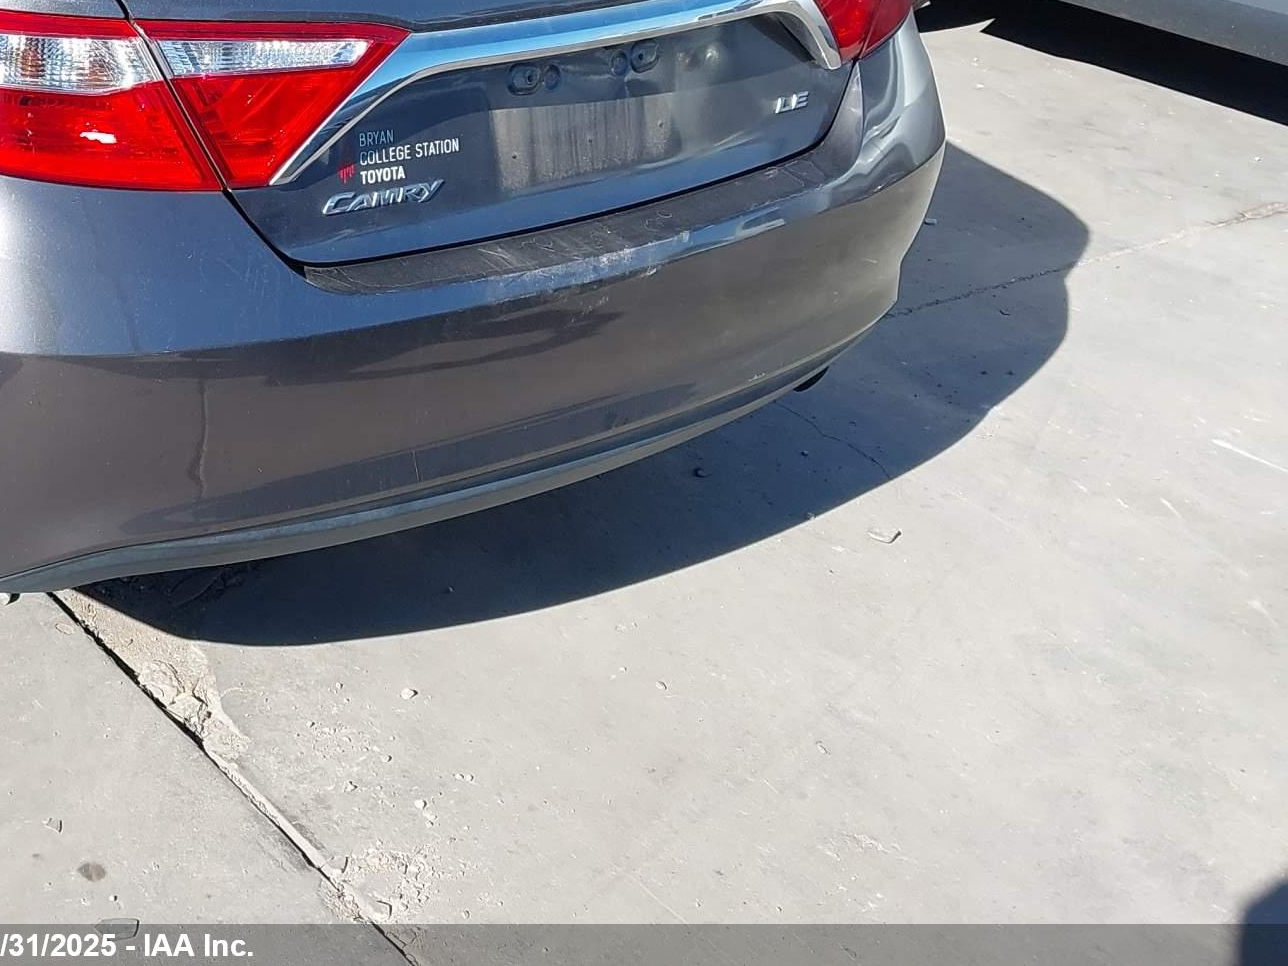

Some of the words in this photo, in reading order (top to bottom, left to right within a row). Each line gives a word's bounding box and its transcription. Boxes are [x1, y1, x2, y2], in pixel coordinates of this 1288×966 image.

[774, 90, 809, 114] LE
[359, 129, 394, 147] BRYAN
[359, 144, 412, 166] COLLEGE
[415, 137, 460, 159] STATION
[359, 165, 405, 185] TOYOTA
[322, 178, 444, 216] CAMRY
